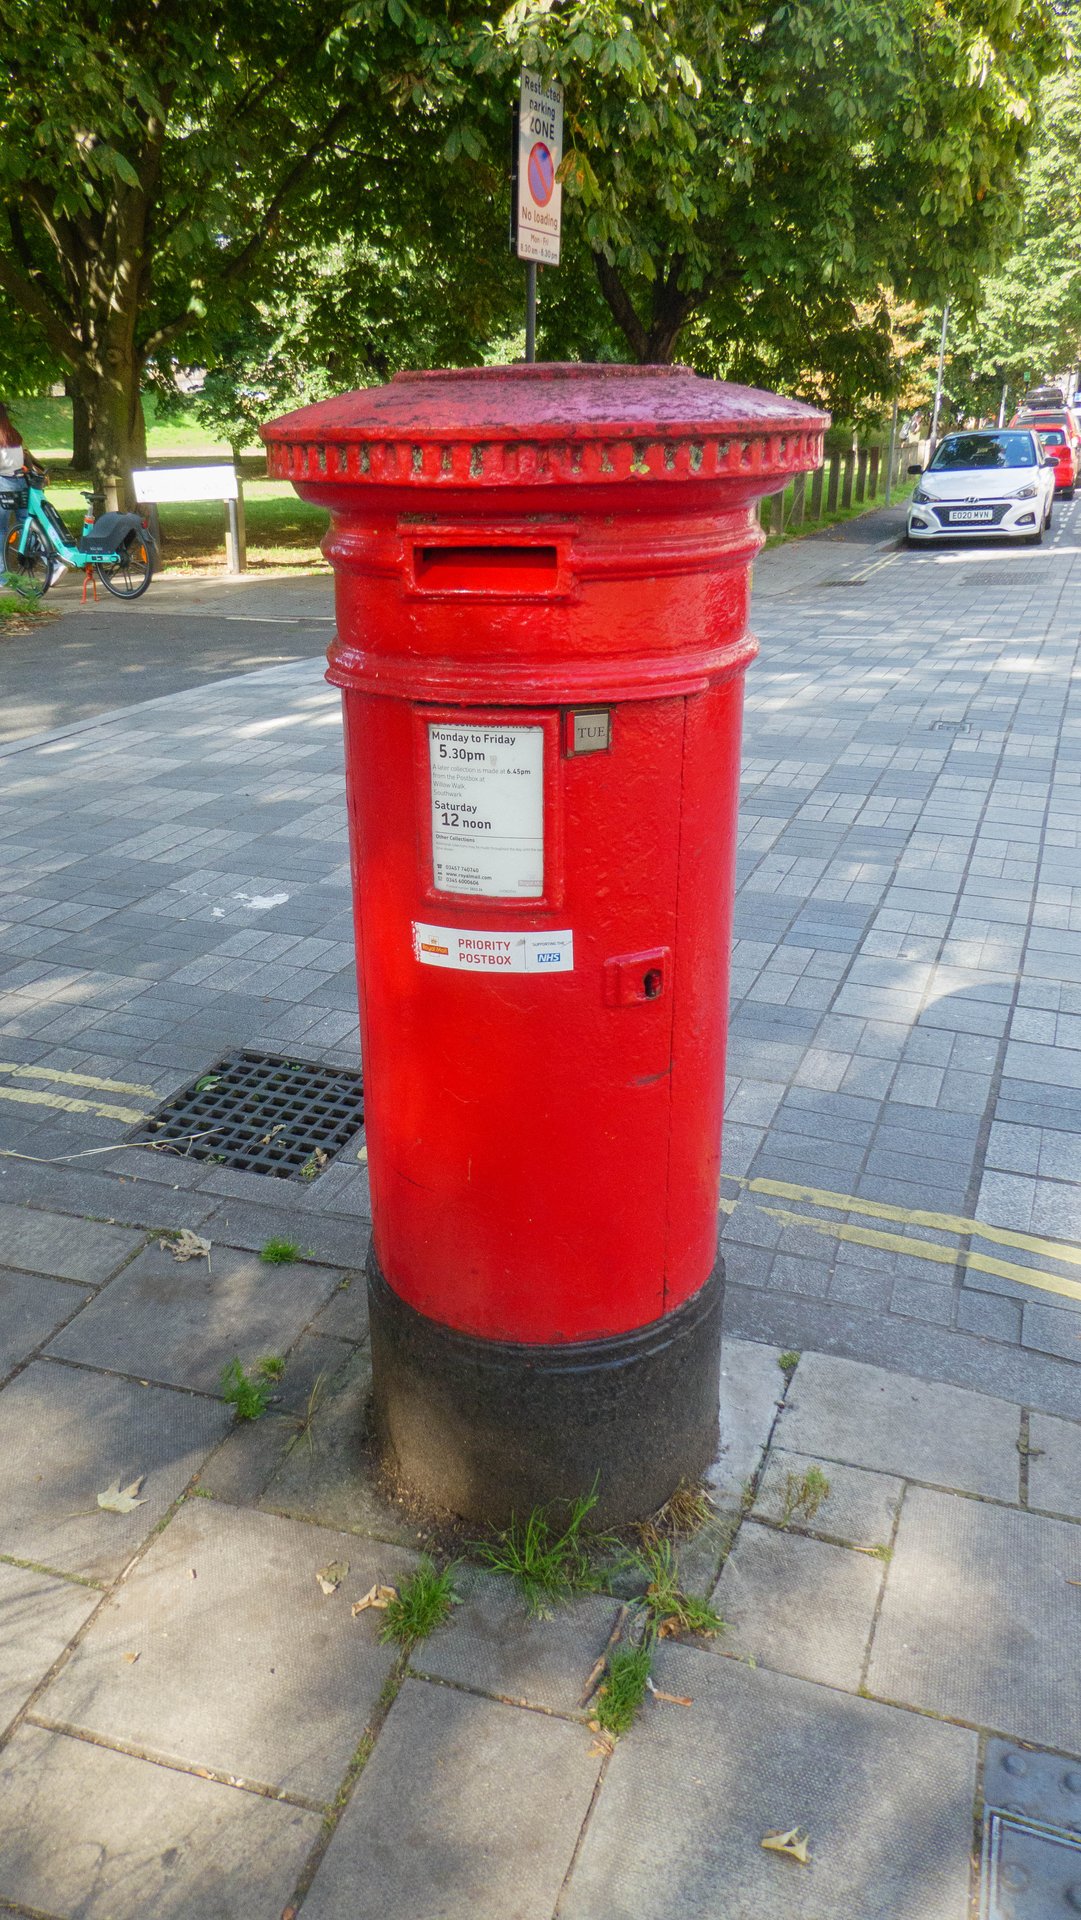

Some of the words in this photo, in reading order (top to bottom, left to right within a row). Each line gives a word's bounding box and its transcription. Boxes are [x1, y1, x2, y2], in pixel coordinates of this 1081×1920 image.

[525, 75, 560, 103] Restcted
[522, 206, 531, 221] No
[534, 210, 558, 230] loading
[531, 233, 540, 243] Mon
[432, 731, 469, 744] Monday
[471, 734, 481, 743] to
[484, 734, 516, 745] Friday
[577, 726, 606, 738] TUE
[439, 744, 485, 762] 5.30pm
[450, 765, 476, 773] collection
[433, 789, 462, 797] Southwark
[434, 800, 477, 814] Saturday
[441, 812, 459, 827] 12
[462, 819, 492, 829] noon
[449, 835, 476, 843] Collections
[458, 938, 511, 951] PRIORITY
[459, 952, 512, 965] POSTBOX
[538, 953, 560, 962] NHS
